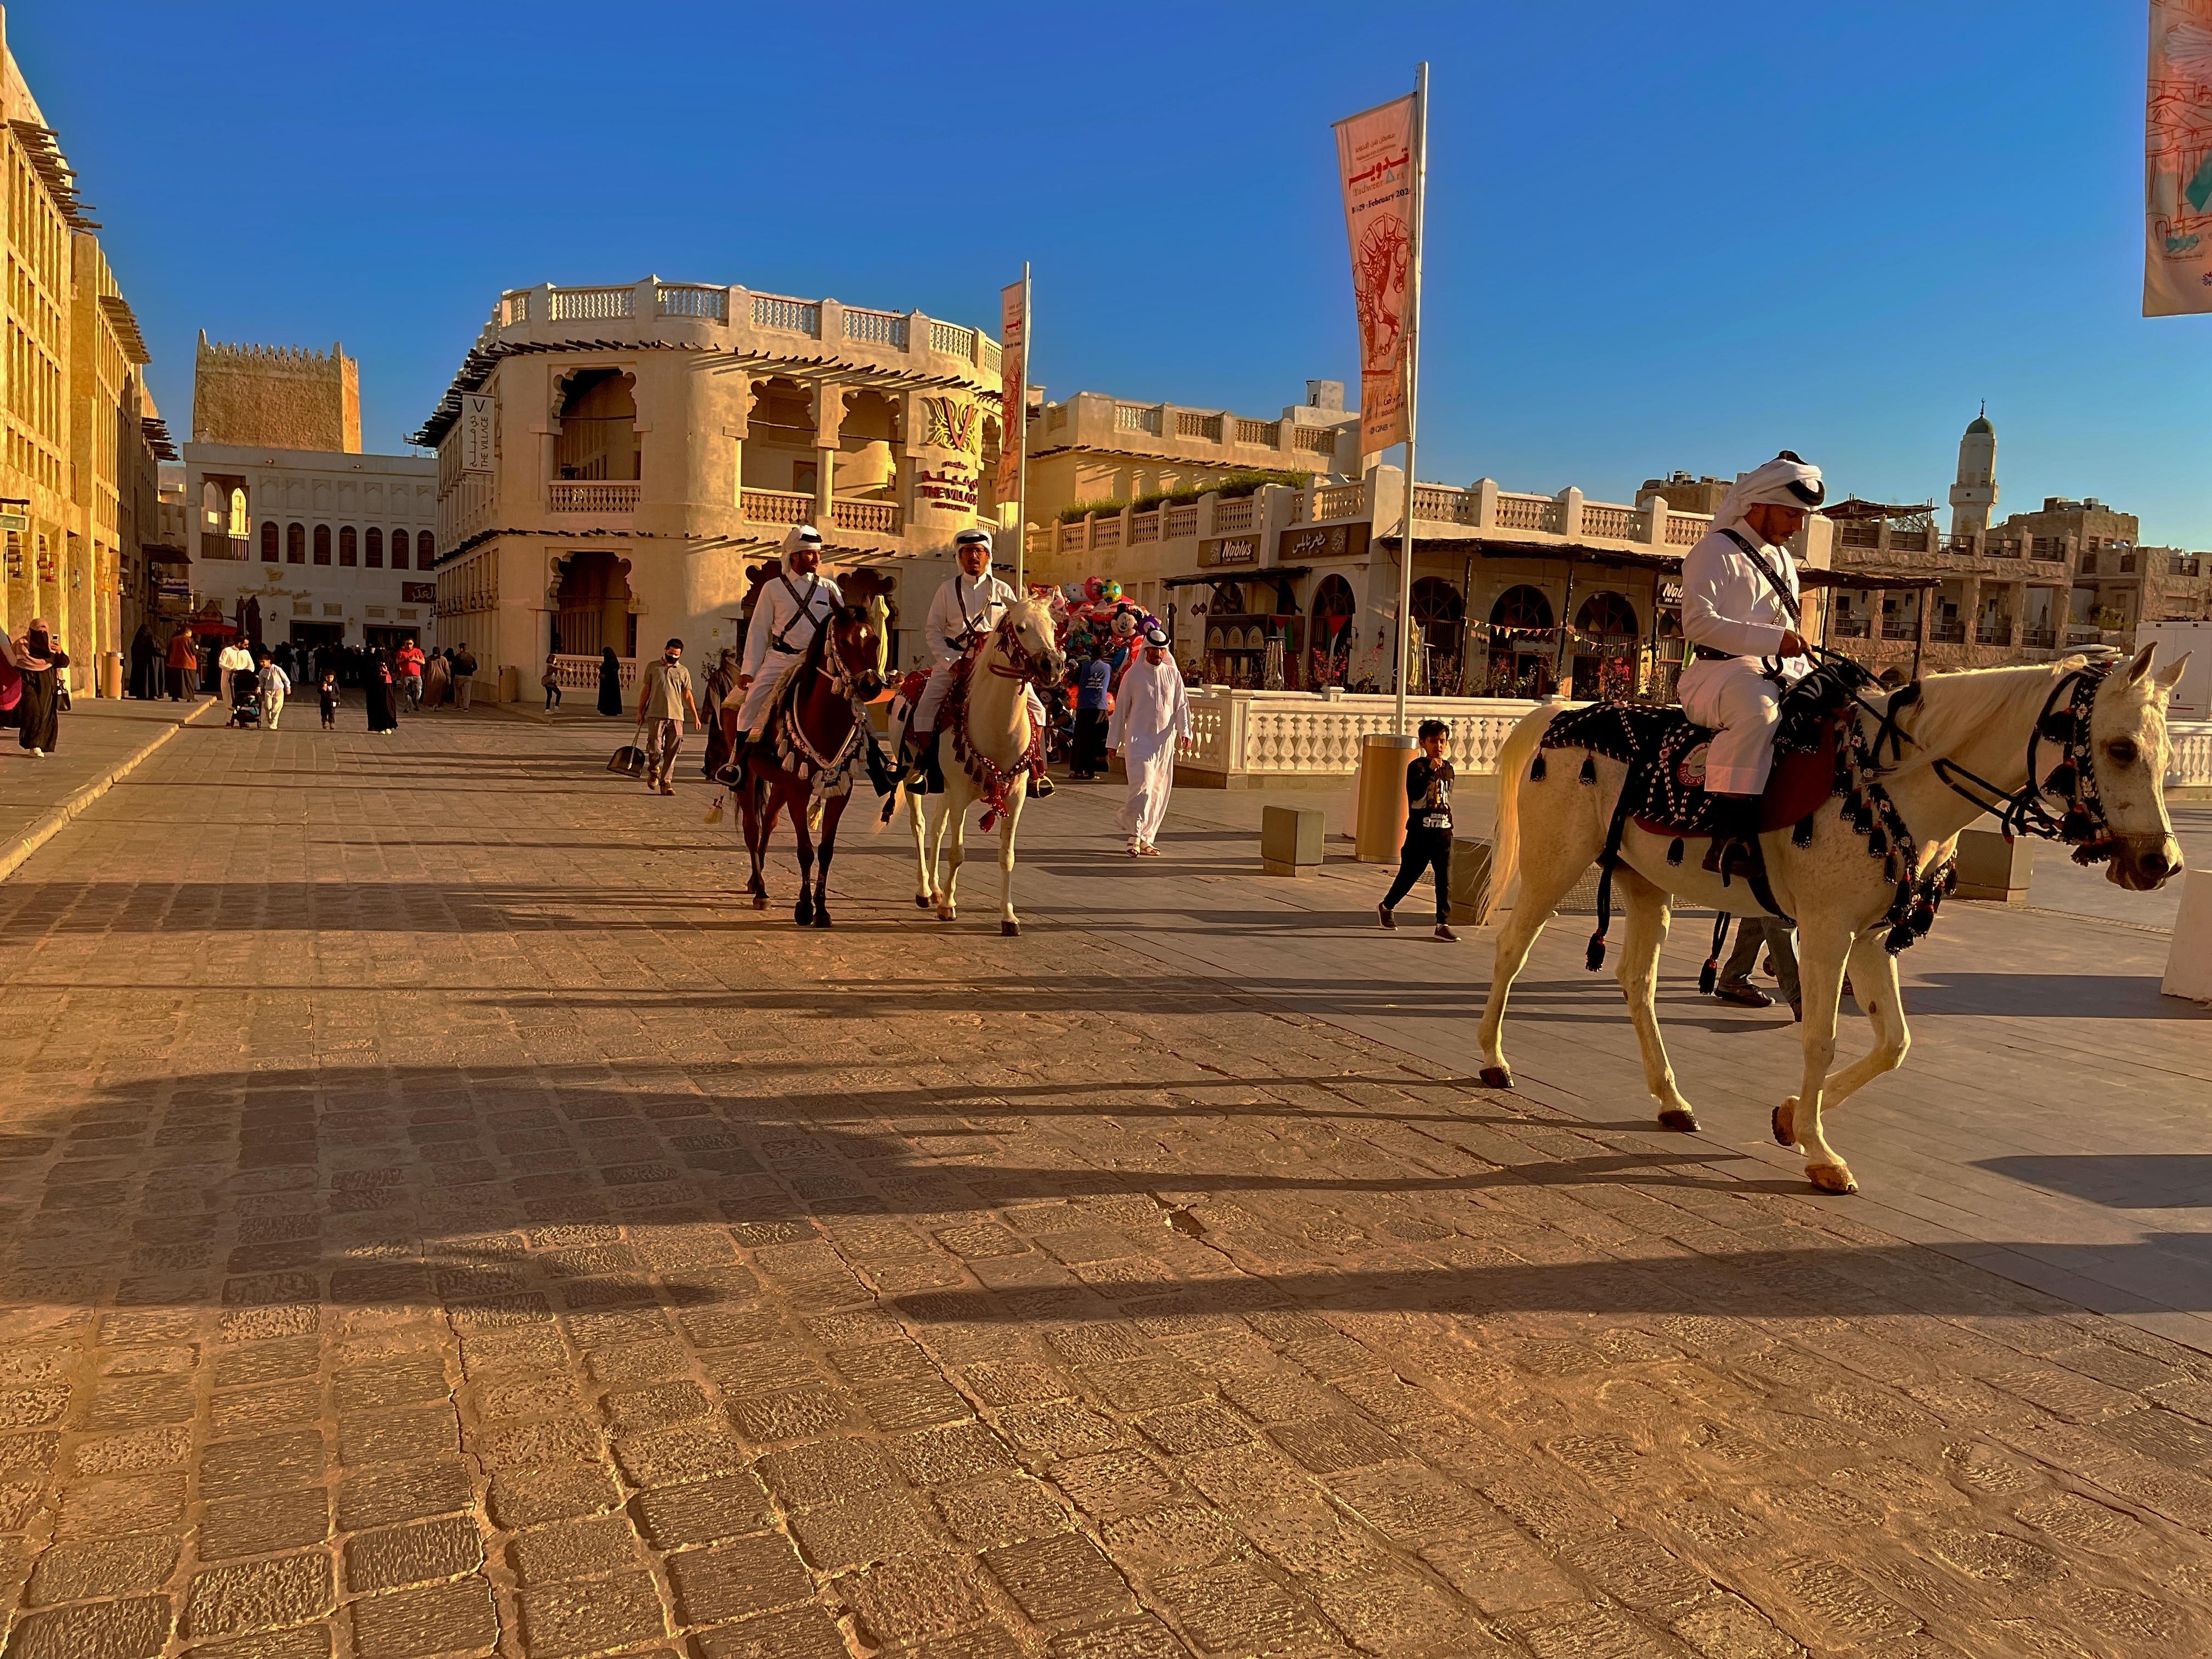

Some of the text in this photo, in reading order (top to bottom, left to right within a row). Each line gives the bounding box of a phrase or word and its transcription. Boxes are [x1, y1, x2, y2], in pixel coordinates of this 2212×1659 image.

[1368, 194, 1395, 208] February
[1375, 424, 1388, 433] QNB
[481, 416, 489, 468] THE VILLAGE
[922, 486, 944, 498] THE
[1222, 540, 1252, 558] Nablus
[1662, 583, 1683, 598] Nab
